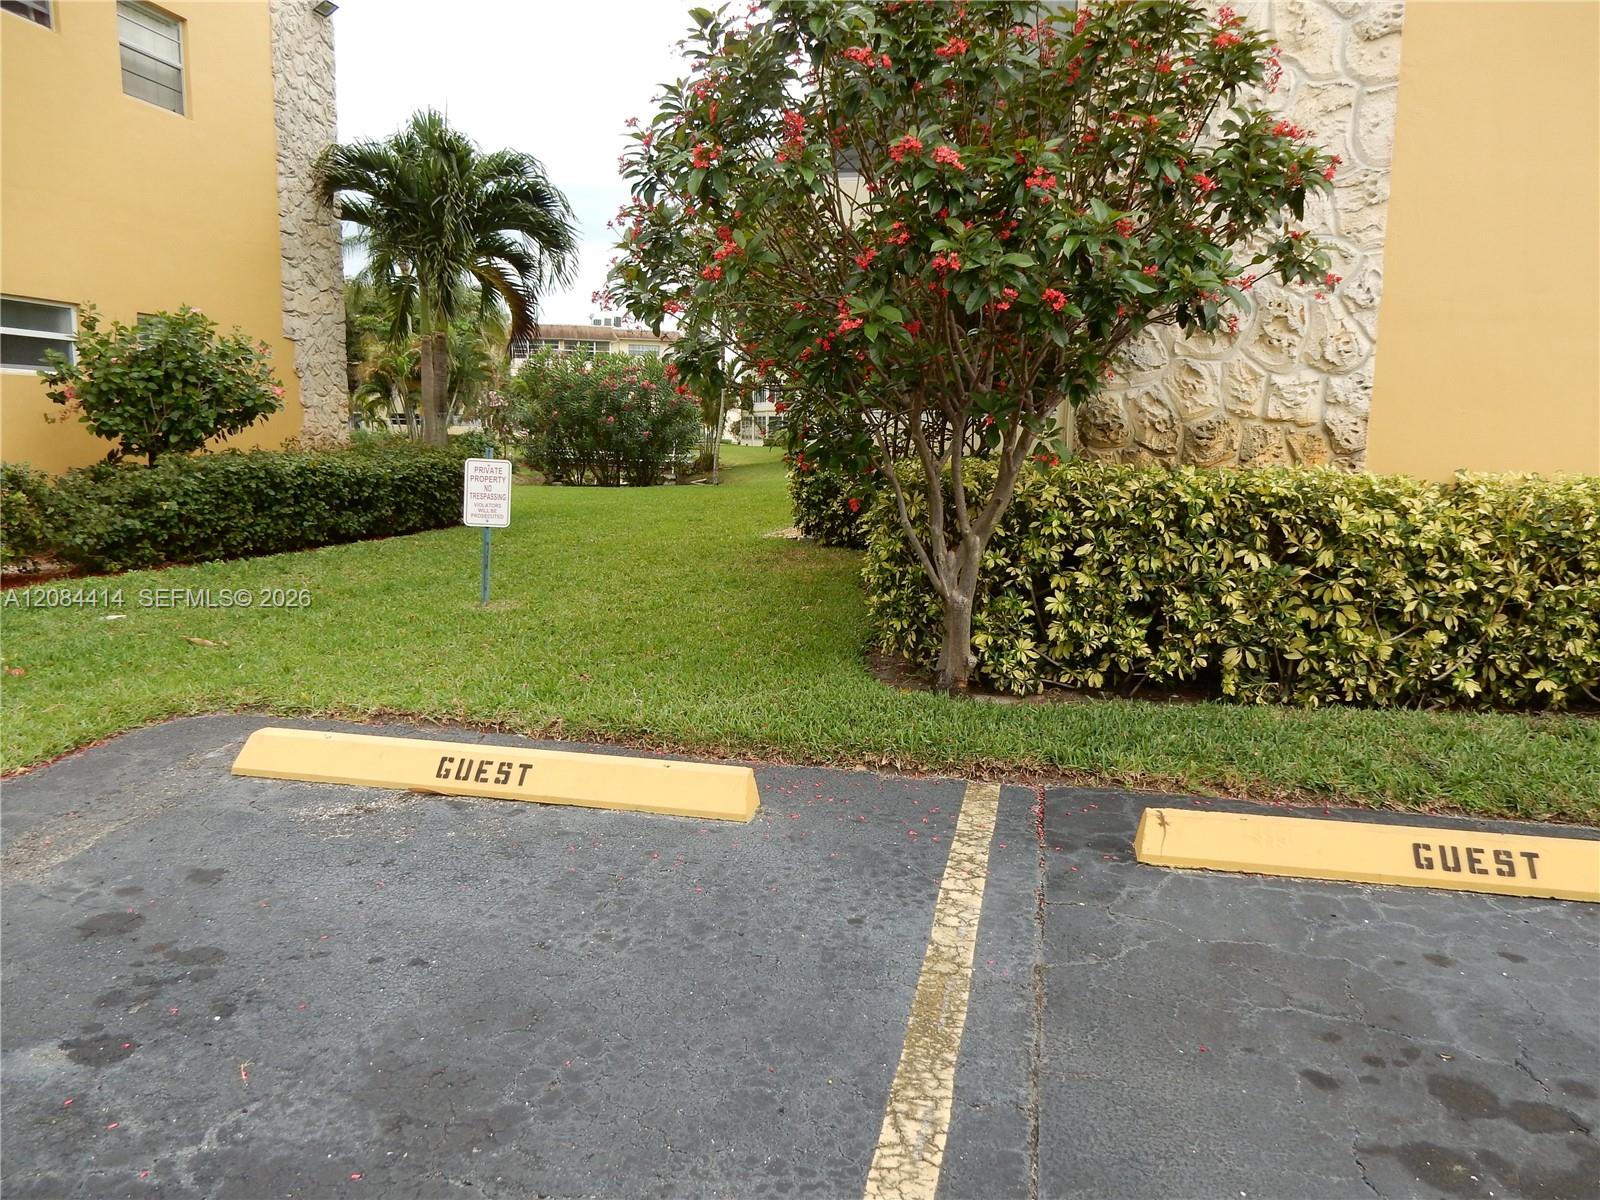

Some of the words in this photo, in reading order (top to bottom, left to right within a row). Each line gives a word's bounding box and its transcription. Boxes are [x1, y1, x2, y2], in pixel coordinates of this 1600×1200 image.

[474, 466, 503, 475] PRIVATE
[470, 475, 506, 483] PROPERTY
[484, 484, 492, 492] NO
[469, 492, 507, 501] TRESPASSING
[435, 756, 533, 787] GUEST
[1412, 842, 1540, 880] GUEST
